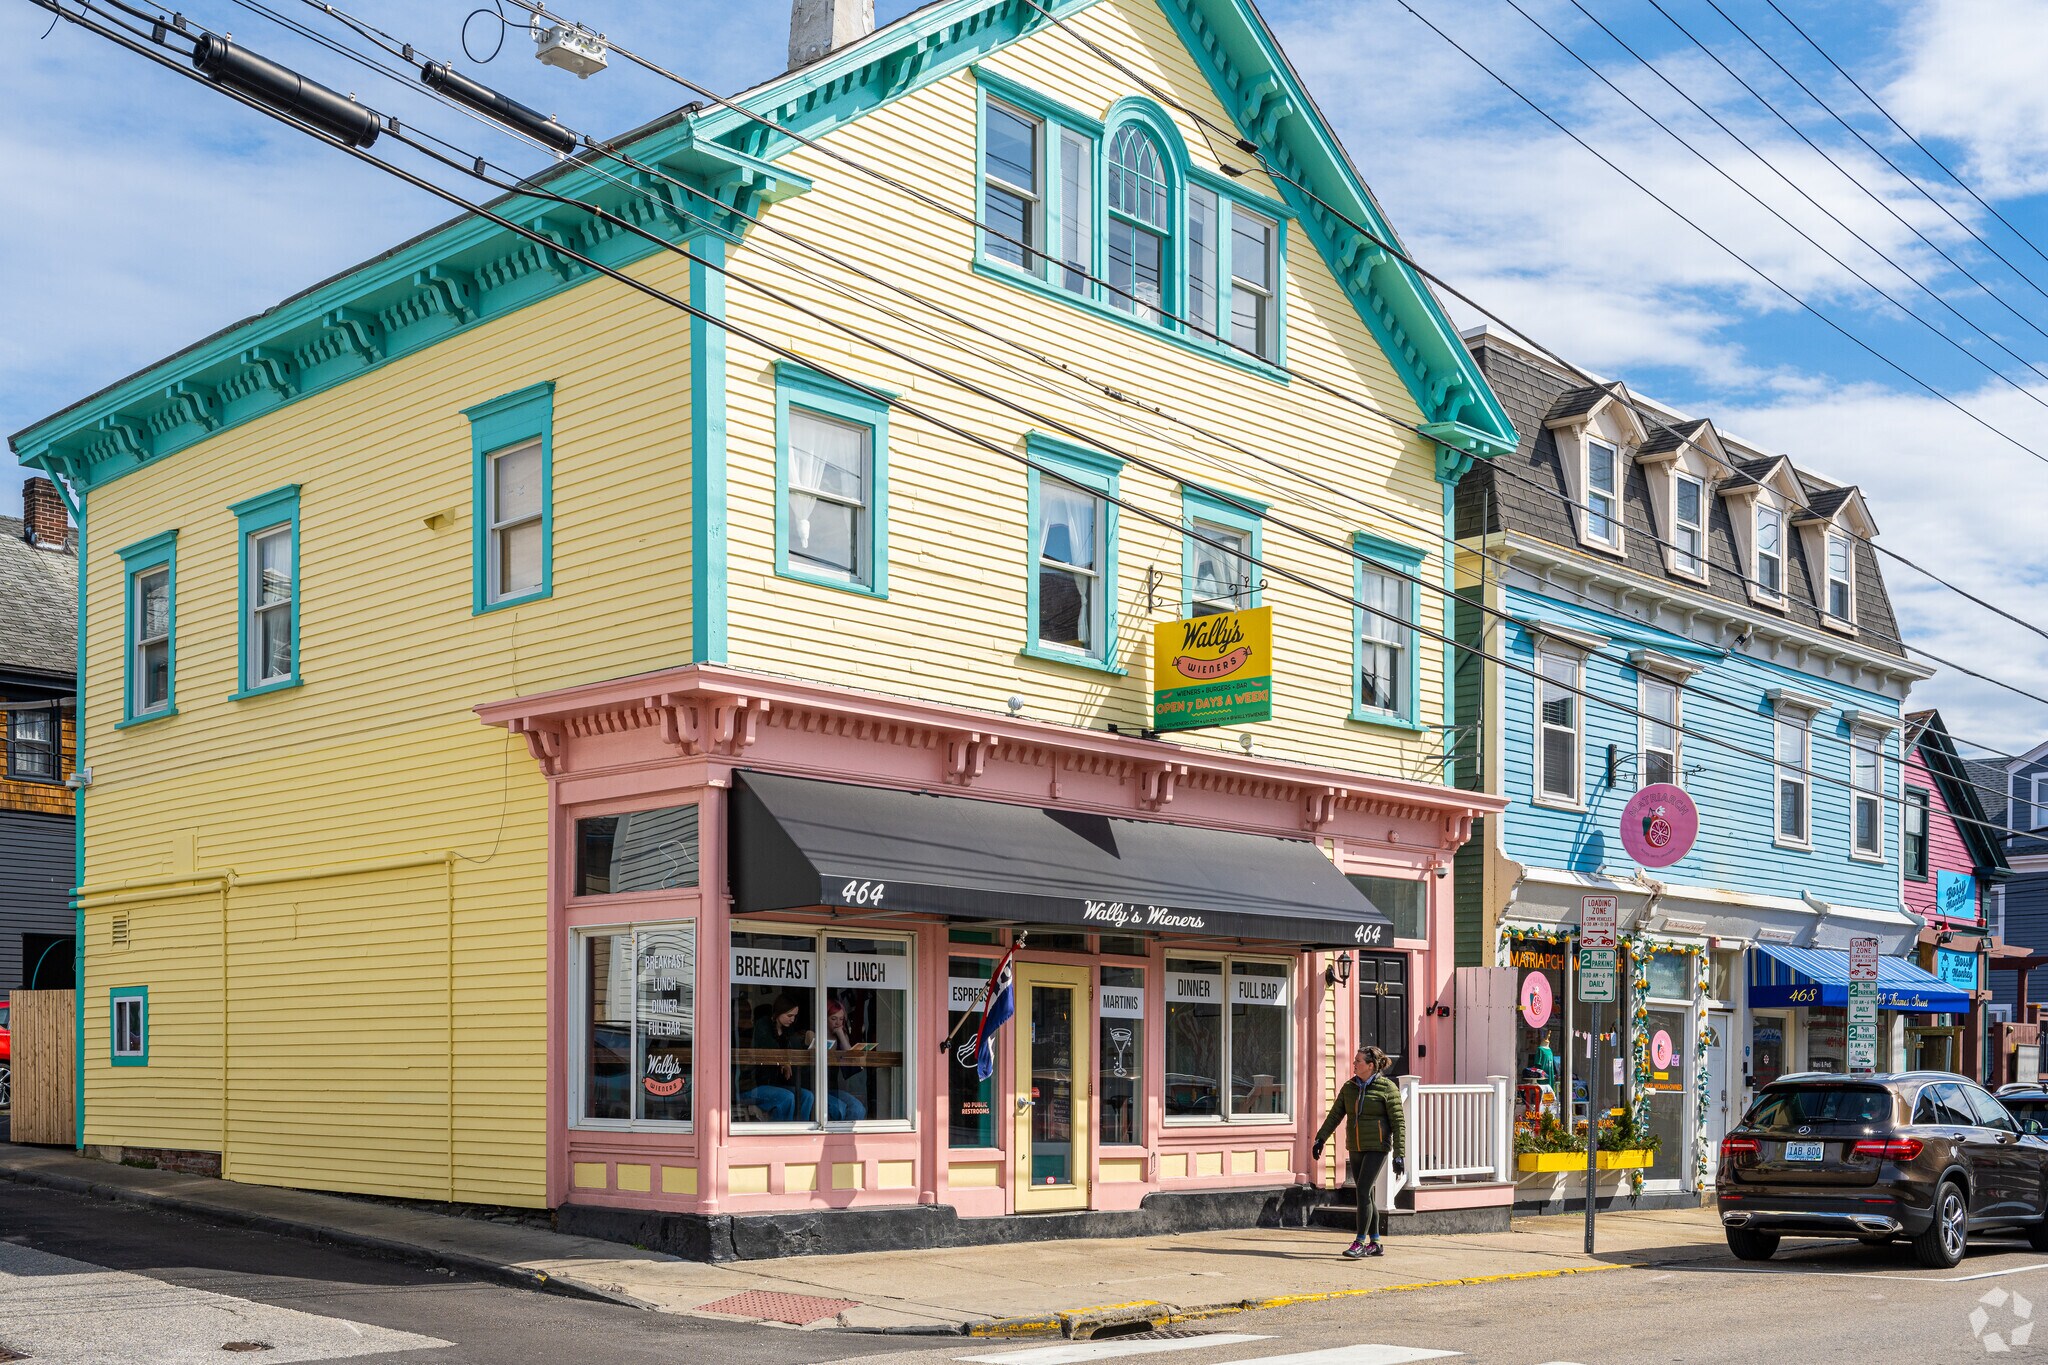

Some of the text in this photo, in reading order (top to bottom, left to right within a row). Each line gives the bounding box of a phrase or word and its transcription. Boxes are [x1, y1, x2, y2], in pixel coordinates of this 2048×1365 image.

[1181, 616, 1244, 654] Wally's
[1187, 656, 1237, 674] WIENERS
[1176, 688, 1201, 697] WIENERS
[1205, 685, 1231, 694] BURGERS
[1156, 689, 1269, 714] OPEN 7 DAYS A WEEK!
[1629, 792, 1689, 818] MATRIARCH
[841, 880, 885, 906] 464
[1588, 899, 1612, 907] LOADING
[1591, 907, 1607, 915] ZONE
[1082, 900, 1205, 928] Wally's Wieners
[1354, 924, 1381, 944] 464
[645, 954, 685, 970] BREAKFAST
[1581, 952, 1591, 966] 2
[735, 955, 810, 981] BREAKFAST
[846, 961, 886, 983] LUNCH
[653, 976, 677, 992] LUNCH
[1177, 978, 1211, 998] DINNER
[1239, 981, 1278, 1000] FULL BAR
[1374, 983, 1389, 997] 464
[1850, 984, 1857, 995] 2
[1102, 994, 1138, 1010] MARTINIS
[1789, 988, 1818, 1002] 468
[1876, 992, 1887, 1005] 68
[1911, 994, 1929, 1007] Street
[651, 999, 678, 1014] DINNER
[648, 1021, 681, 1036] FULL BAR
[1849, 1028, 1857, 1039] 2
[646, 1054, 682, 1079] Wally's
[650, 1082, 677, 1092] WIENERS
